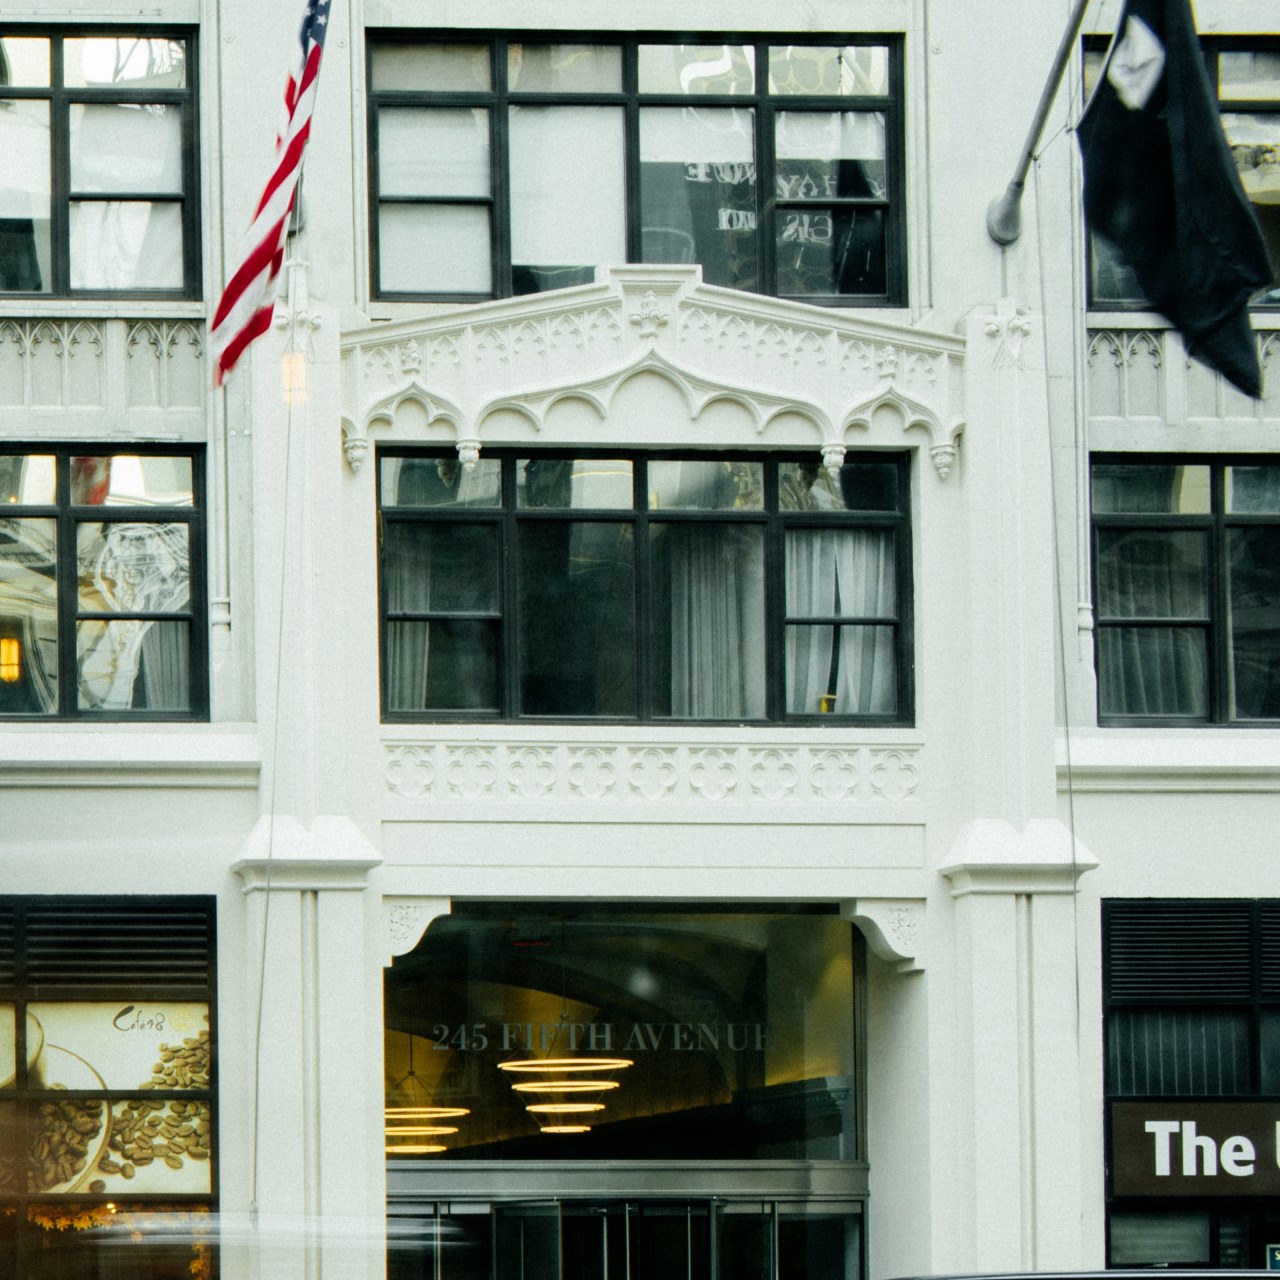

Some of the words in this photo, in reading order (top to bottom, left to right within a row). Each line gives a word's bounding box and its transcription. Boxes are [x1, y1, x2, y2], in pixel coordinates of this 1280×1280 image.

[432, 1023, 489, 1051] 245
[500, 1023, 623, 1051] FIFTH
[627, 1023, 776, 1051] AVENUE
[1144, 1120, 1256, 1177] The
